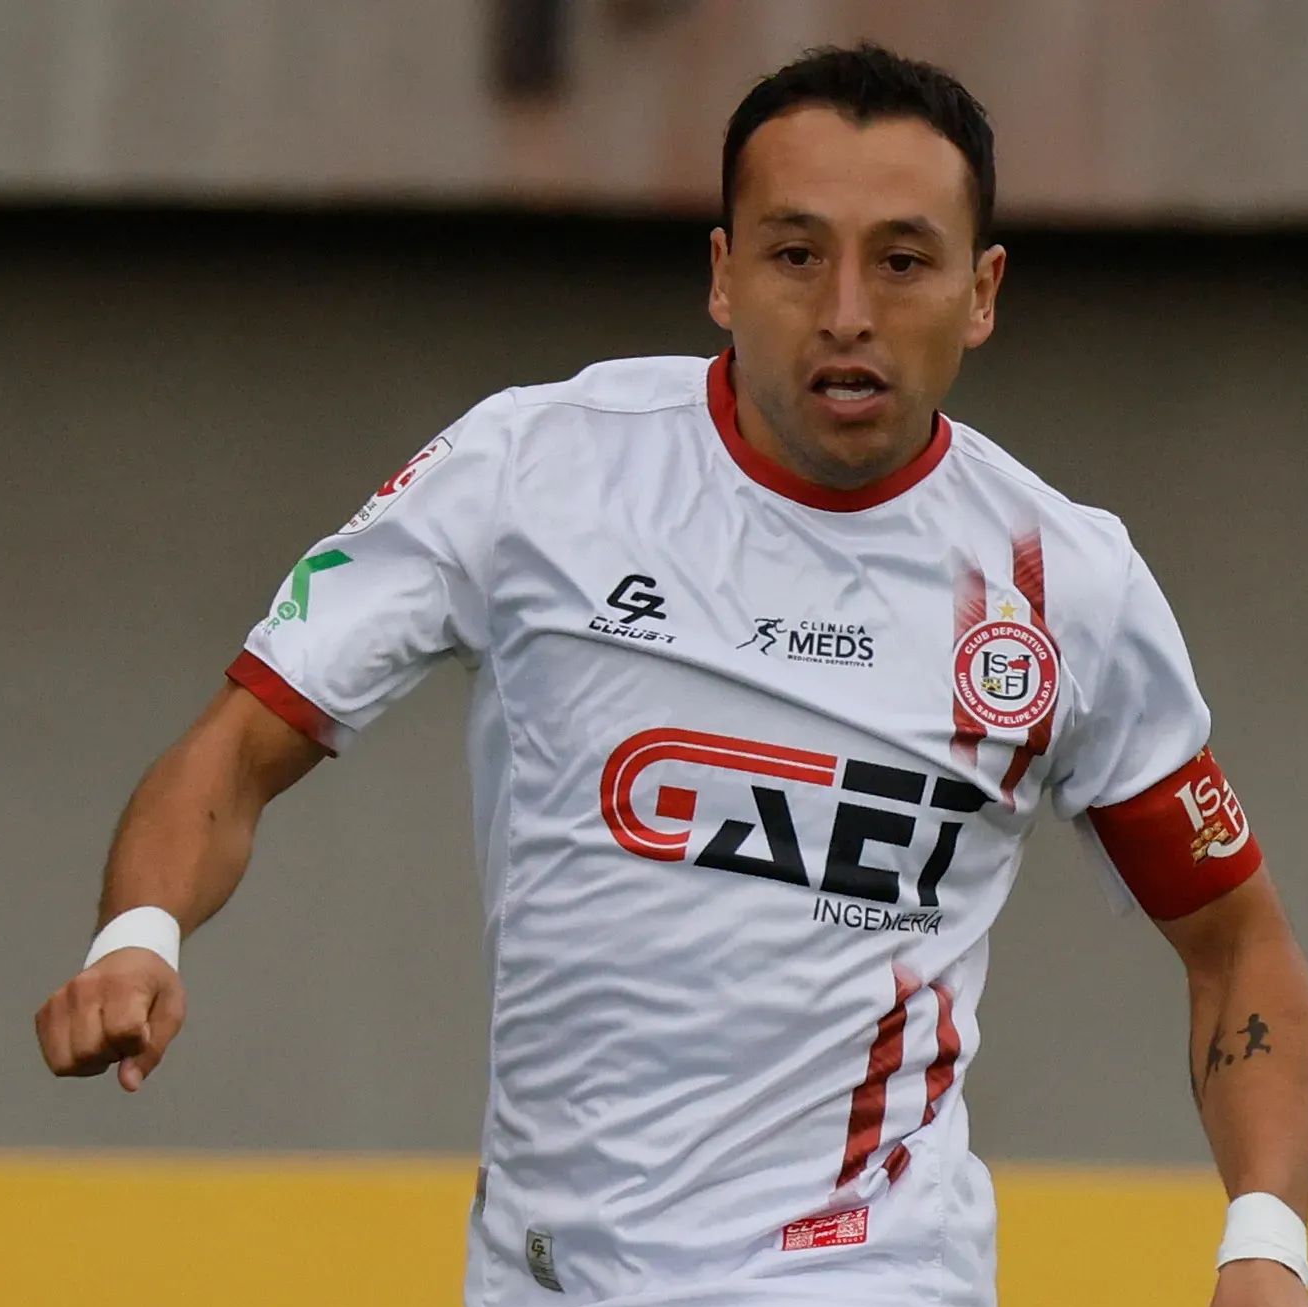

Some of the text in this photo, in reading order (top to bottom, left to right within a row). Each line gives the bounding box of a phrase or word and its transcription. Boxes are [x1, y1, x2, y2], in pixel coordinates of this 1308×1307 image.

[799, 620, 866, 635] CLINICA
[787, 630, 874, 661] MEDS
[964, 626, 1048, 660] CLUB DEPORTIVO
[787, 654, 866, 667] MEDICINA DEPORTIVA
[975, 703, 996, 722] SAN
[997, 711, 1032, 725] FELIPE
